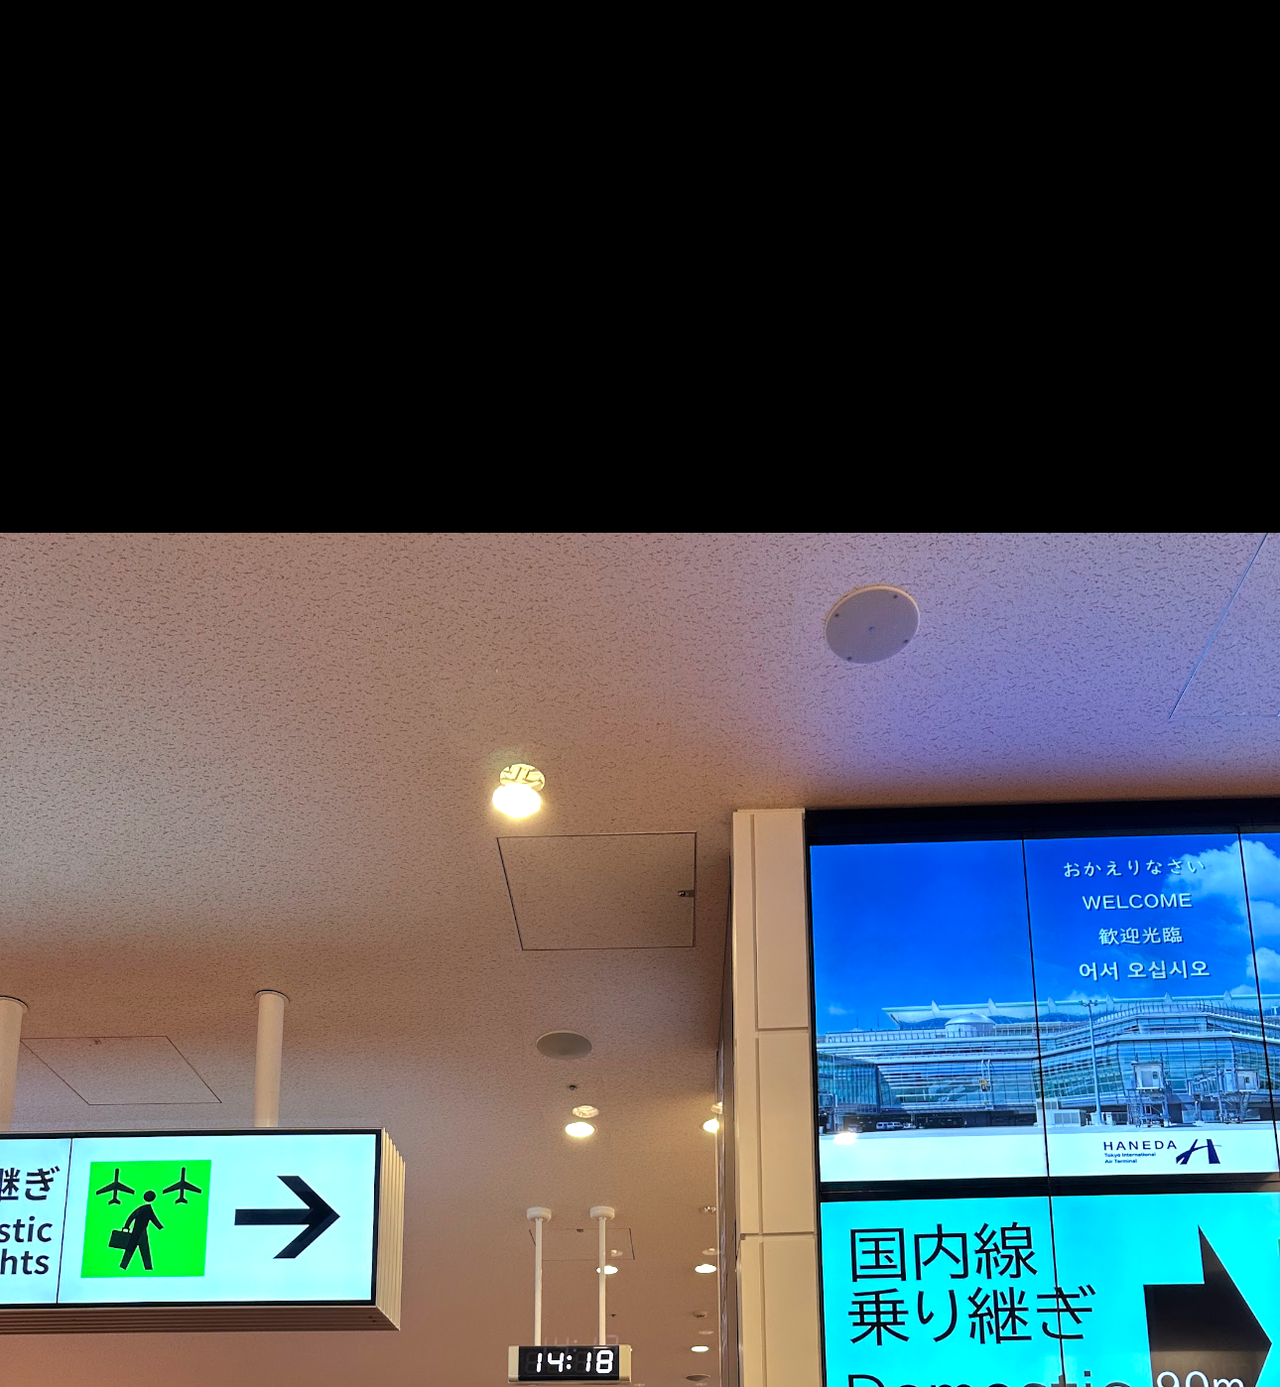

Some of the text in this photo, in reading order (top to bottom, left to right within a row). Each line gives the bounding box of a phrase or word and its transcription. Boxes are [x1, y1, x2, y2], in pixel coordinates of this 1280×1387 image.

[1063, 859, 1206, 878] おかえりなさい
[1082, 893, 1192, 910] WELCOME
[1099, 927, 1183, 945] 歓迎光臨
[1079, 960, 1211, 981] 어서 오십시오
[1103, 1140, 1177, 1151] HANEDA
[850, 1221, 1038, 1282] 国内線
[848, 1284, 1097, 1346] 乗り継ぎ
[536, 1350, 614, 1374] 14:18
